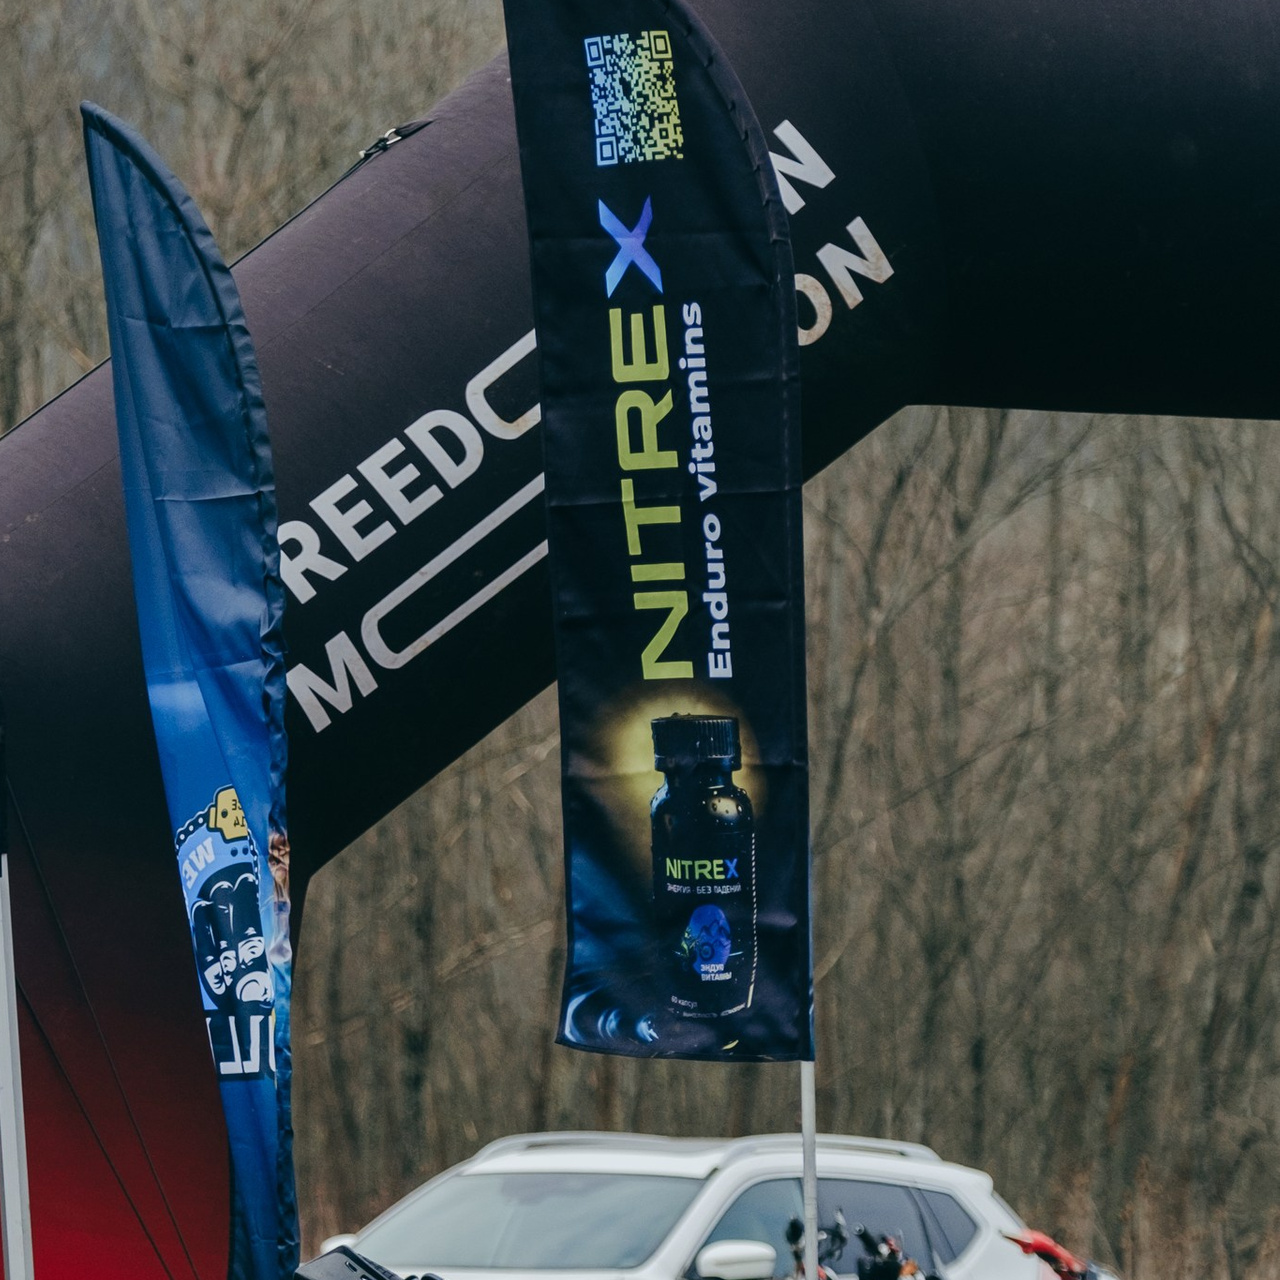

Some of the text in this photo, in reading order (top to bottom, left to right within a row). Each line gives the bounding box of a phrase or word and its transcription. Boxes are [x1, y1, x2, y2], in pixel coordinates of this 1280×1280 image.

[598, 195, 695, 680] NITREX
[679, 302, 734, 679] Enduro vitamins
[665, 857, 739, 880] NITREX
[696, 886, 712, 895] БЕЗ
